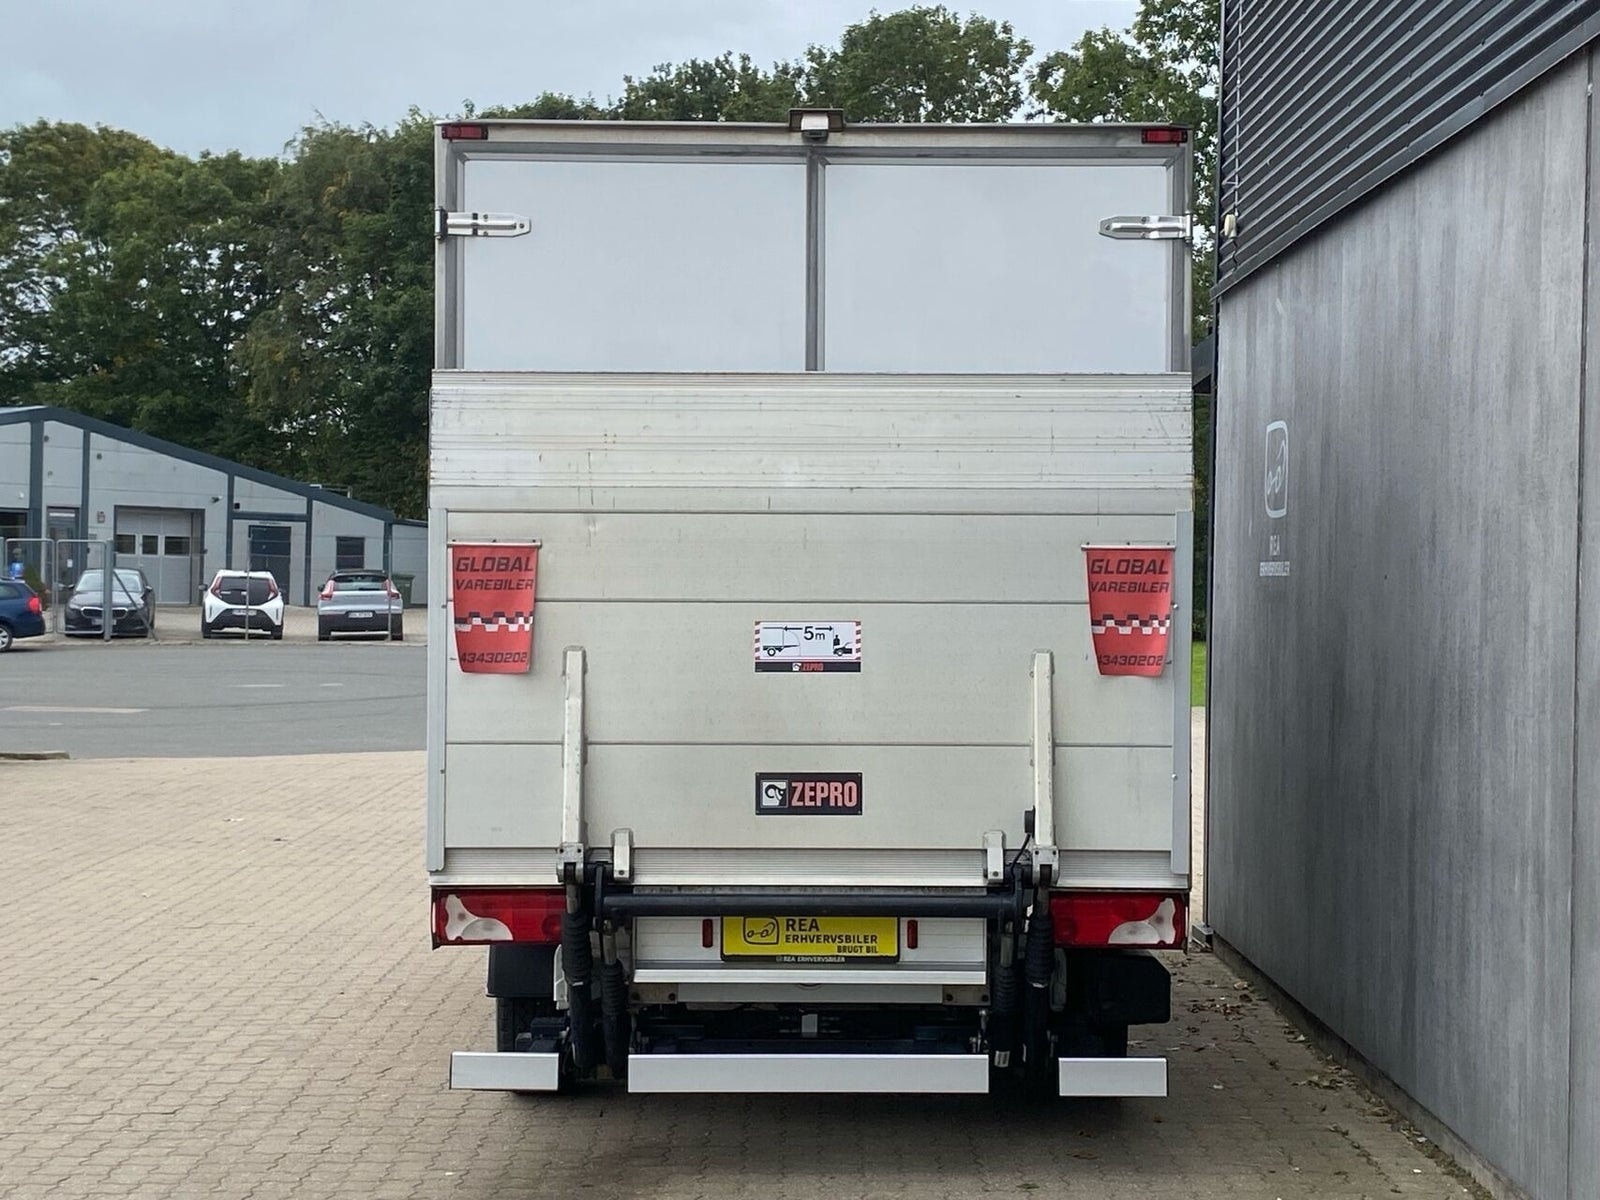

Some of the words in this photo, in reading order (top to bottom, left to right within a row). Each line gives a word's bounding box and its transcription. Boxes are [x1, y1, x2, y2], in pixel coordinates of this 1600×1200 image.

[455, 556, 534, 572] GLOBAL
[1090, 559, 1169, 575] GLOBAL
[455, 578, 535, 591] VAREBILER
[1090, 581, 1170, 593] VAREBILER
[791, 781, 858, 807] ZEPRO
[785, 918, 820, 932] REA
[785, 934, 878, 944] ERHVERVSBILER
[837, 945, 863, 954] BRUGT
[865, 945, 878, 954] BIL
